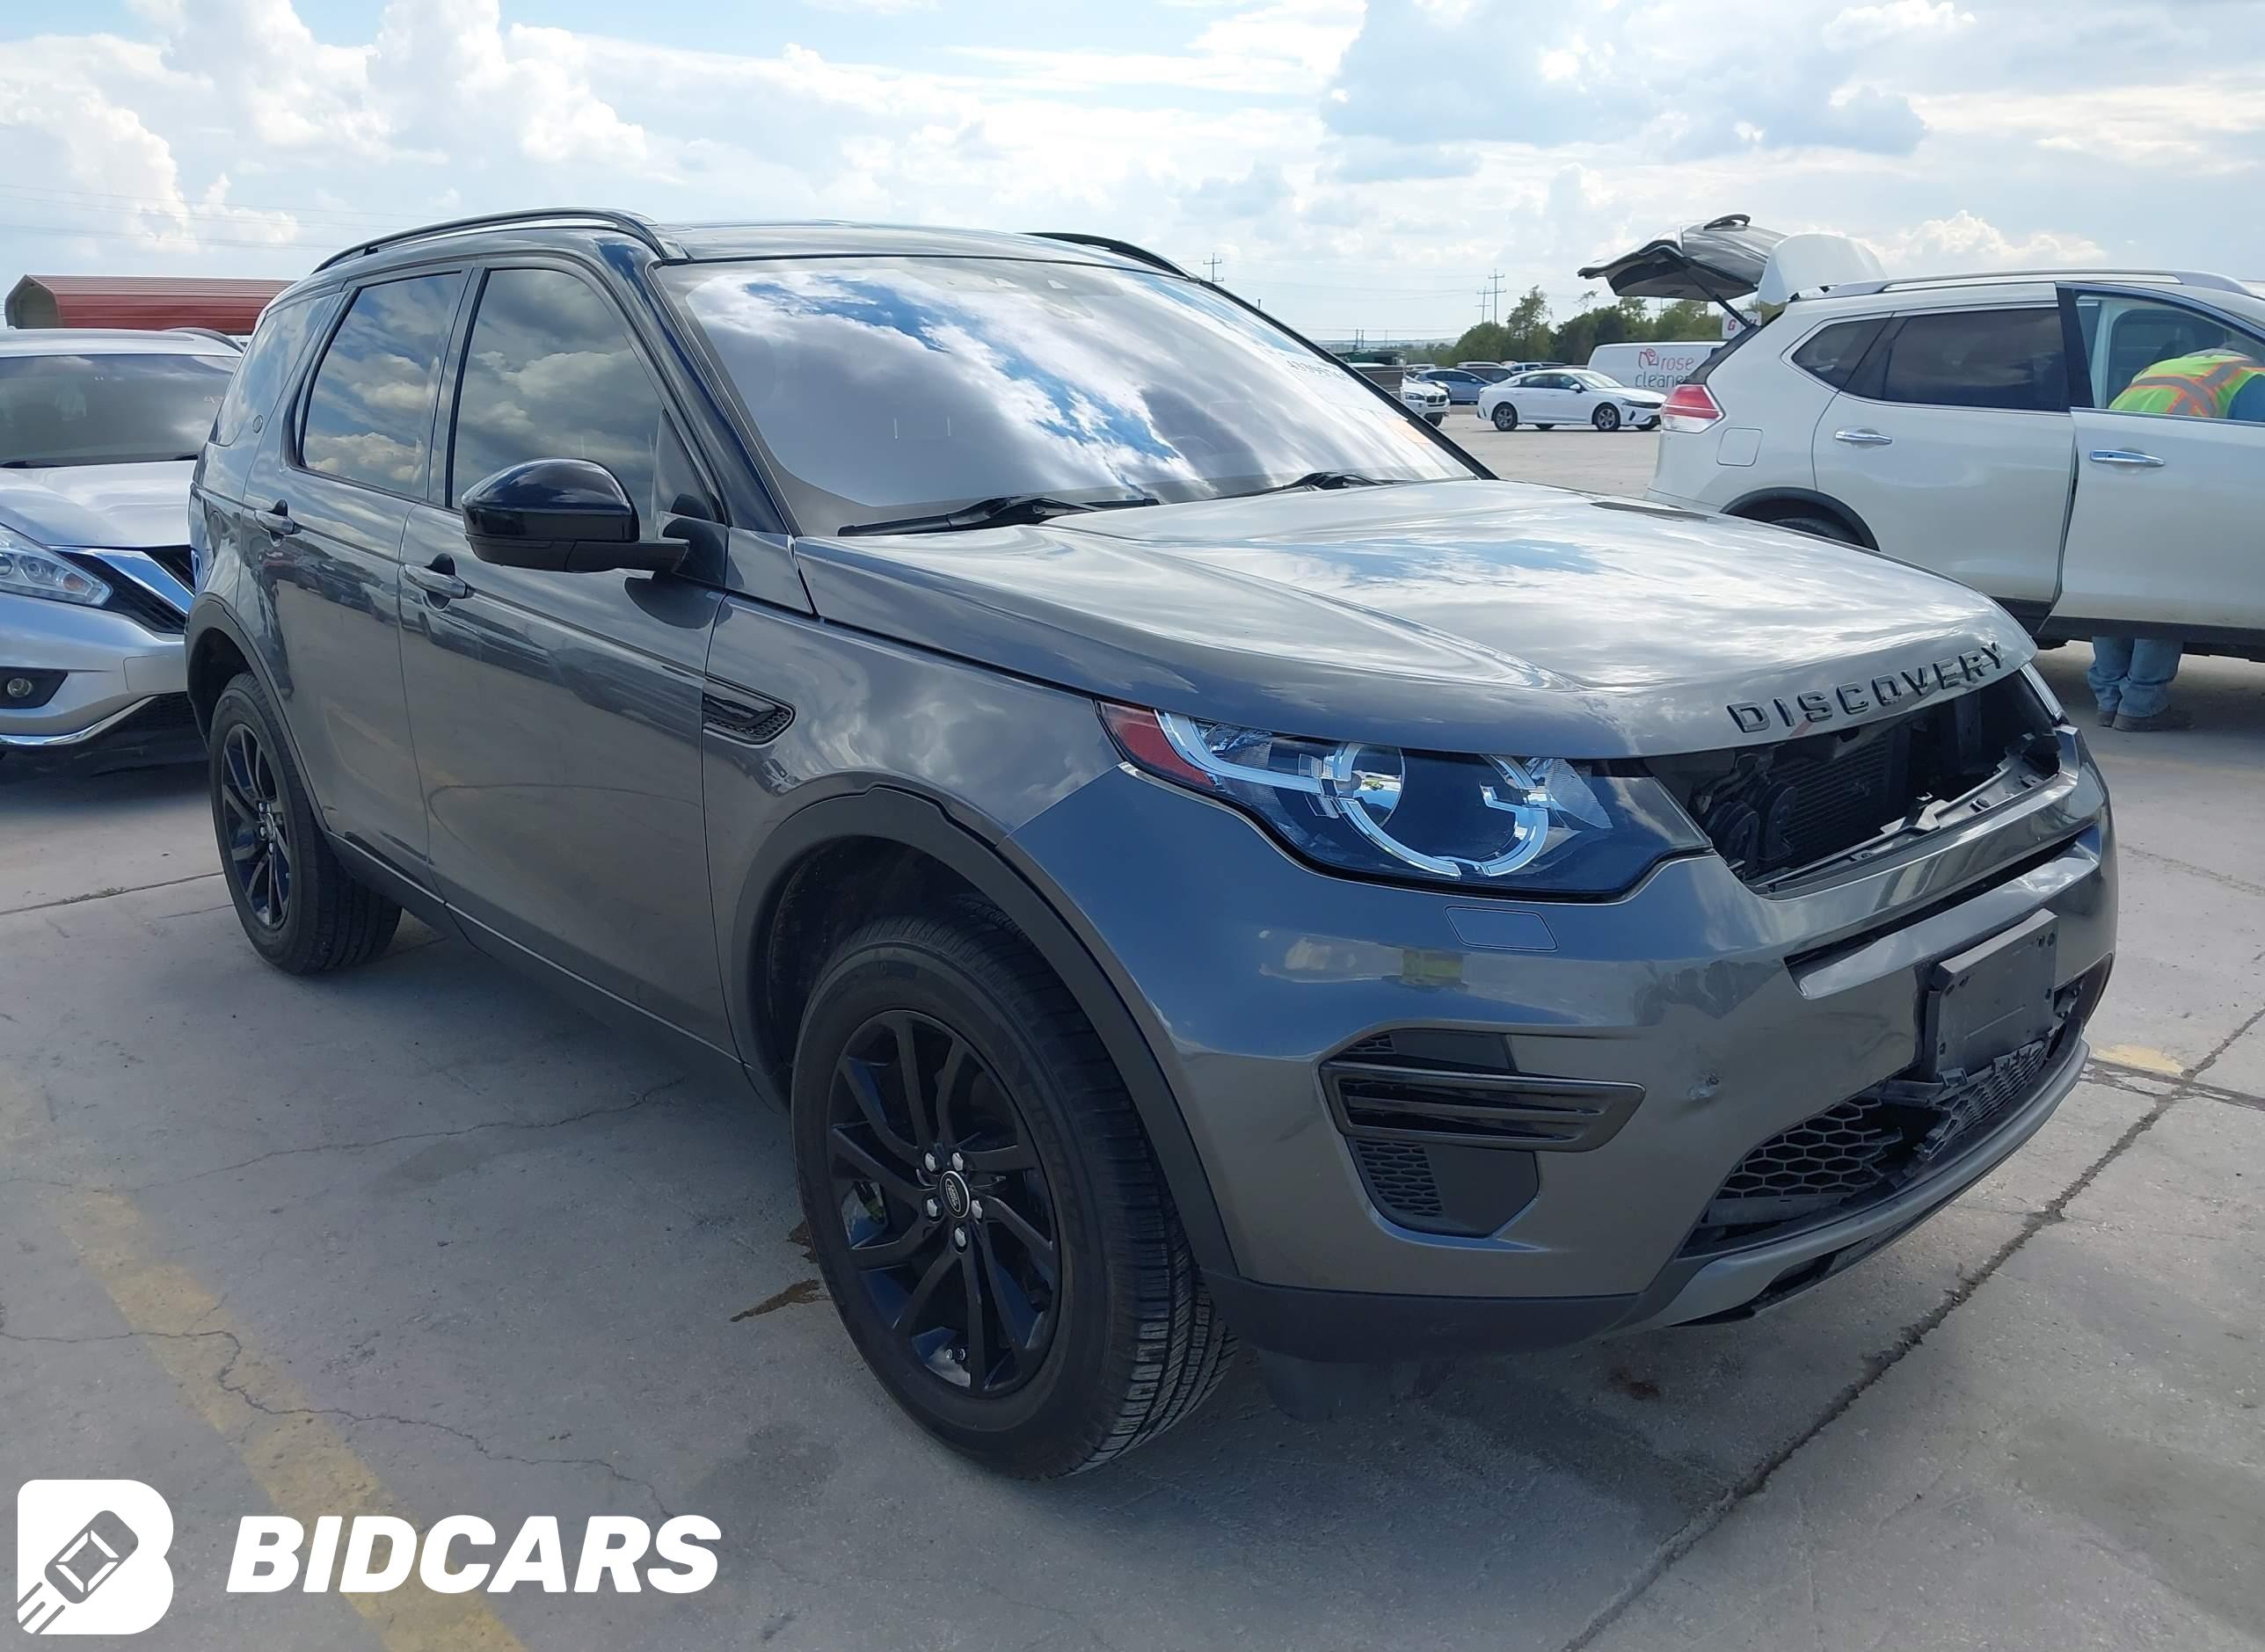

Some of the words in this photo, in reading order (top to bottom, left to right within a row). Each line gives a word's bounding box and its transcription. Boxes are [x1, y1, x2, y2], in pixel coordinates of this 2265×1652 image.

[1660, 357, 1695, 370] rose
[1635, 371, 1687, 388] cleane
[1726, 642, 2006, 732] DISCOVERY
